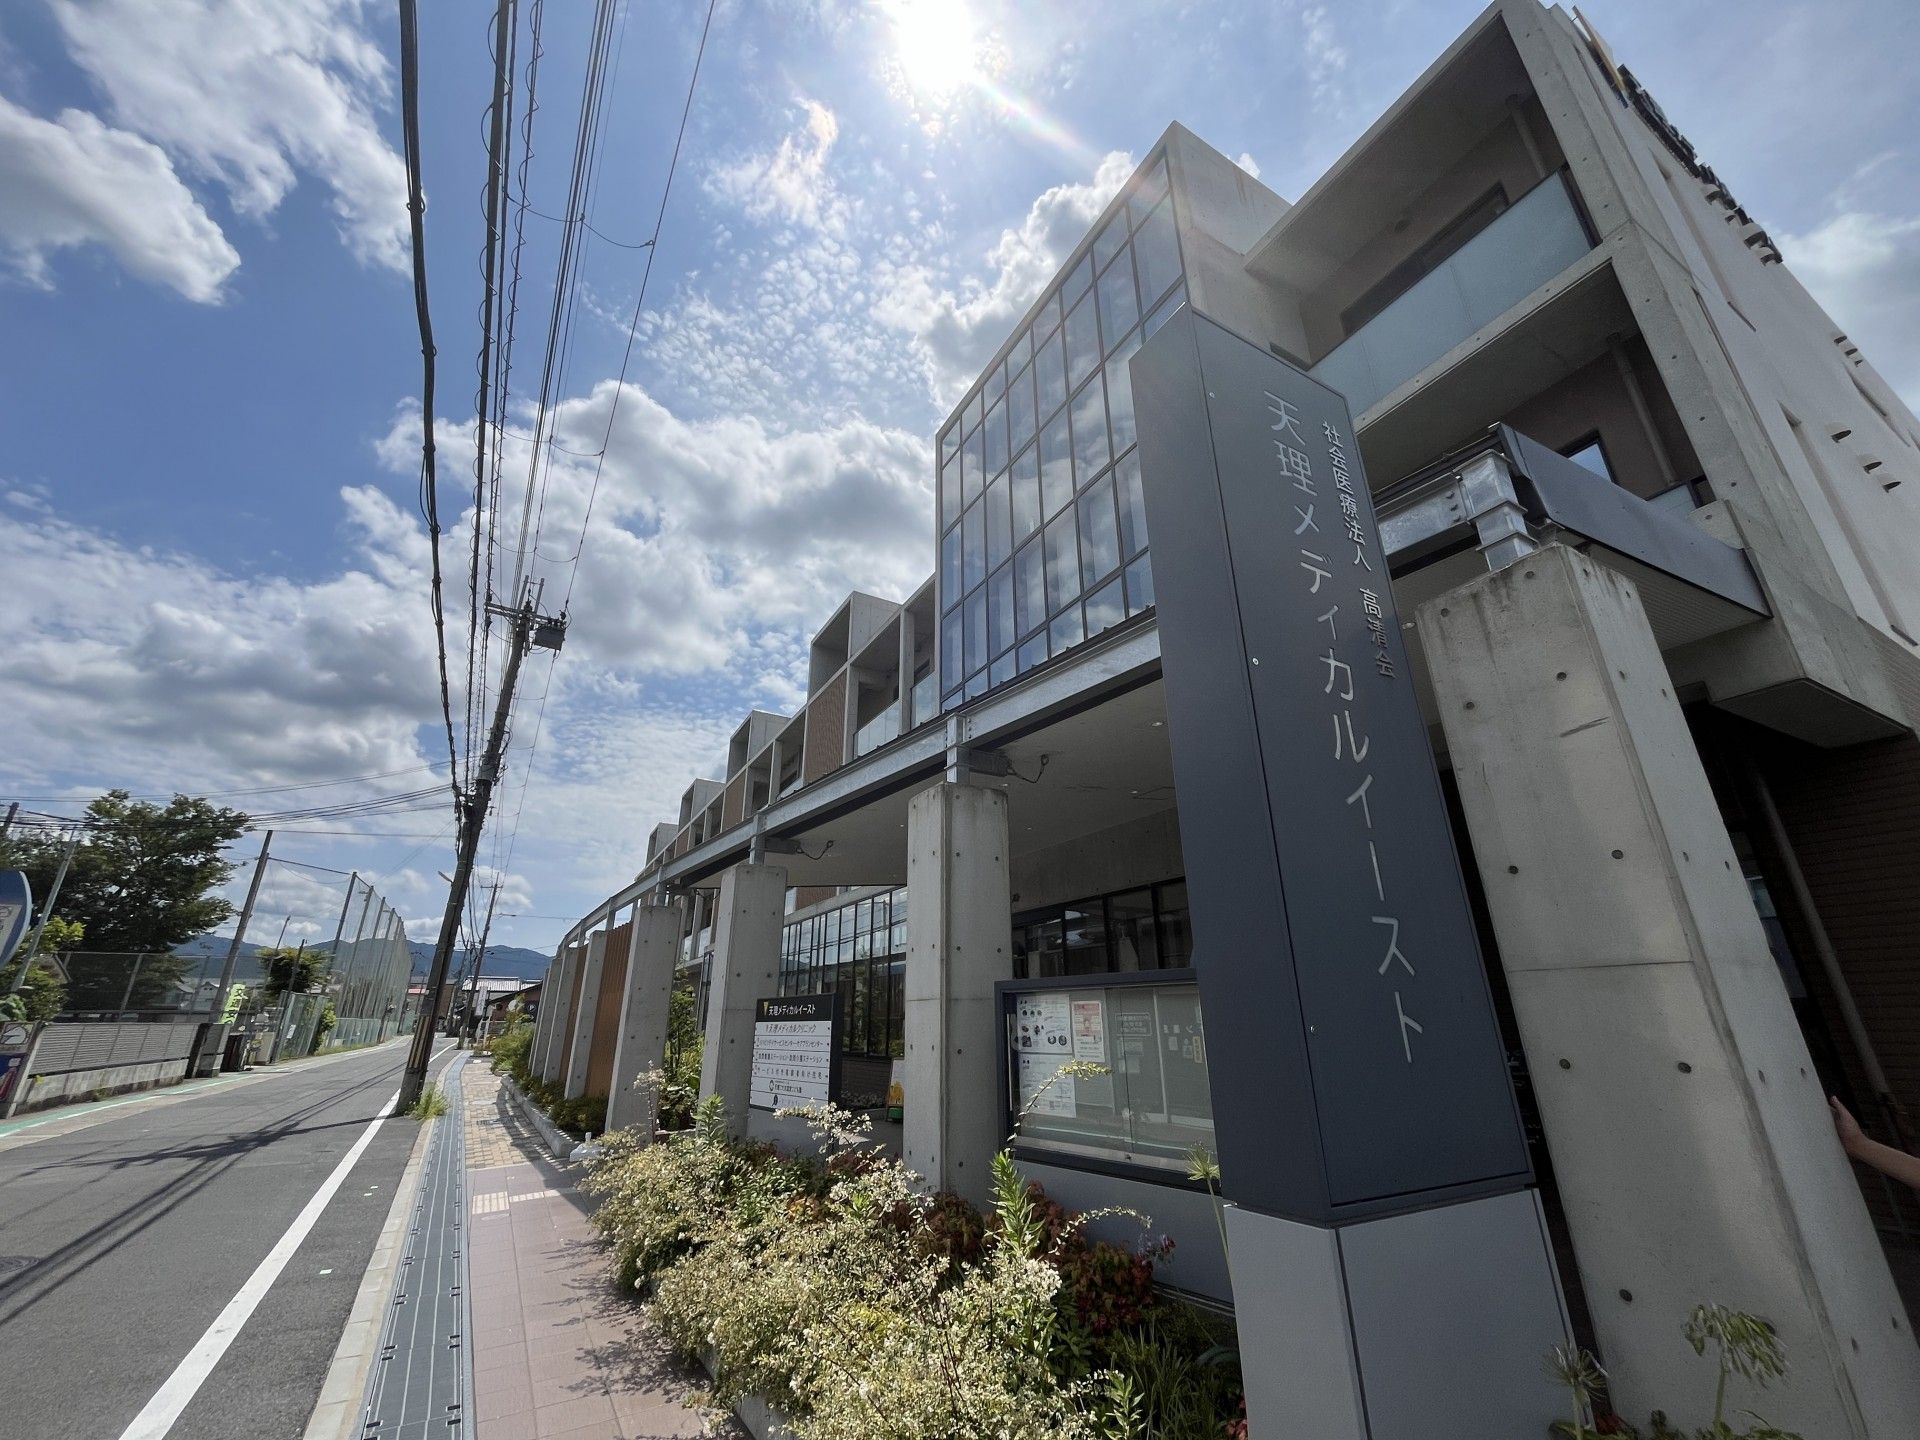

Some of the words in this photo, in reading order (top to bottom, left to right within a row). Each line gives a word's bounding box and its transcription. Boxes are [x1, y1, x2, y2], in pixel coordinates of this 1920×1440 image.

[1322, 421, 1372, 571] 社会医療法人
[1263, 390, 1423, 1064] 天理メディカルイースト
